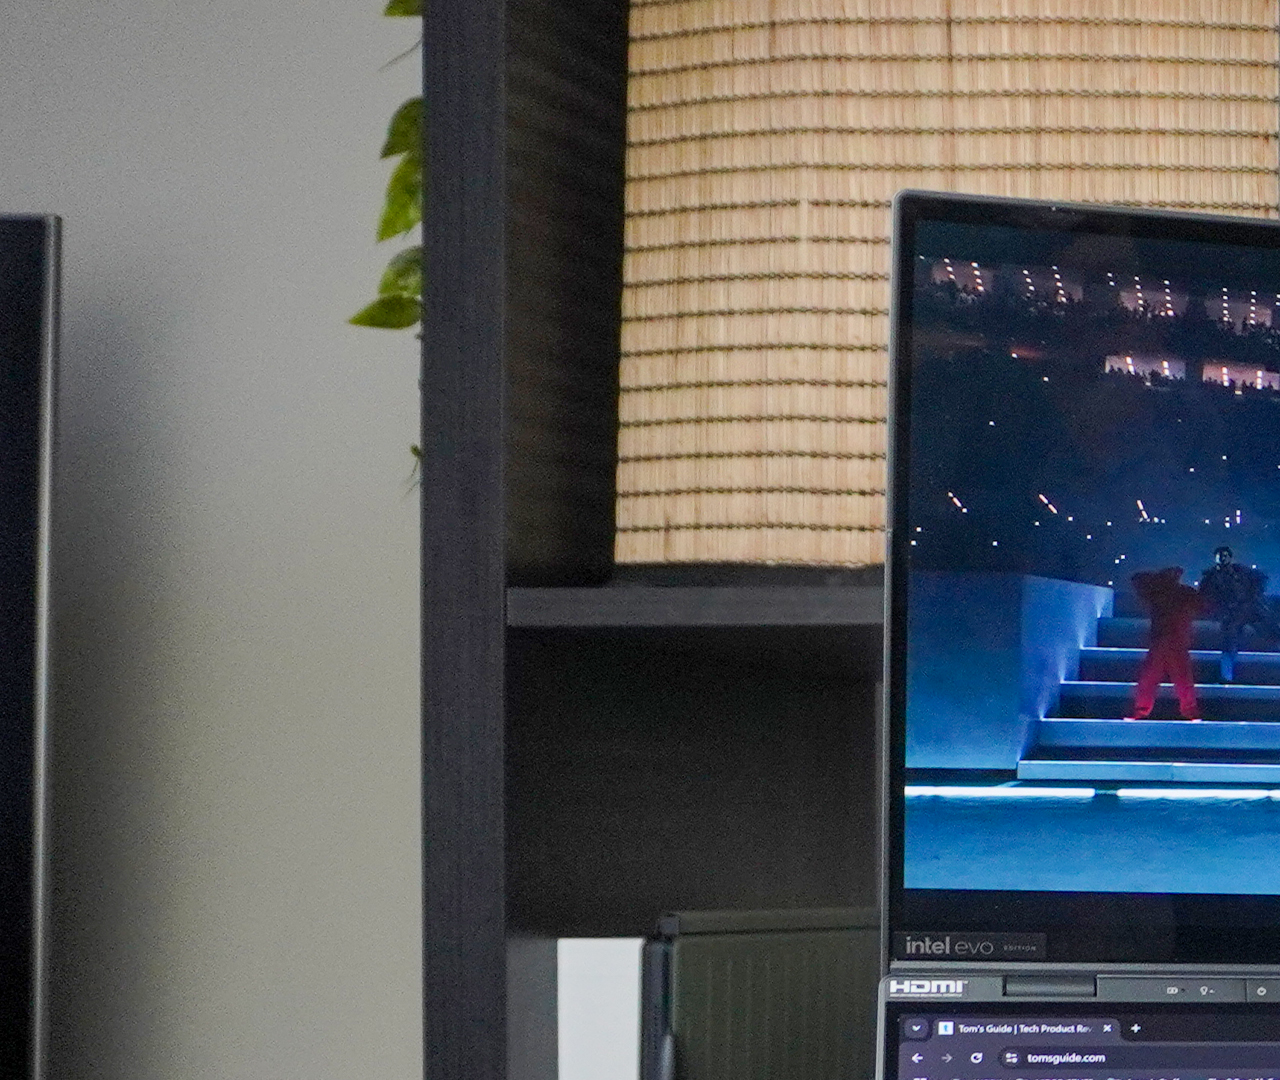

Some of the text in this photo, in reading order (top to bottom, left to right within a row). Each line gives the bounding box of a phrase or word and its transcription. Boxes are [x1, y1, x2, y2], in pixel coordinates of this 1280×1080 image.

[905, 936, 950, 955] intel
[955, 940, 994, 955] evo
[889, 980, 963, 993] HDMI
[958, 1023, 1078, 1034] Tom's Guide Tech Product
[1027, 1053, 1106, 1066] tomsguide.com
